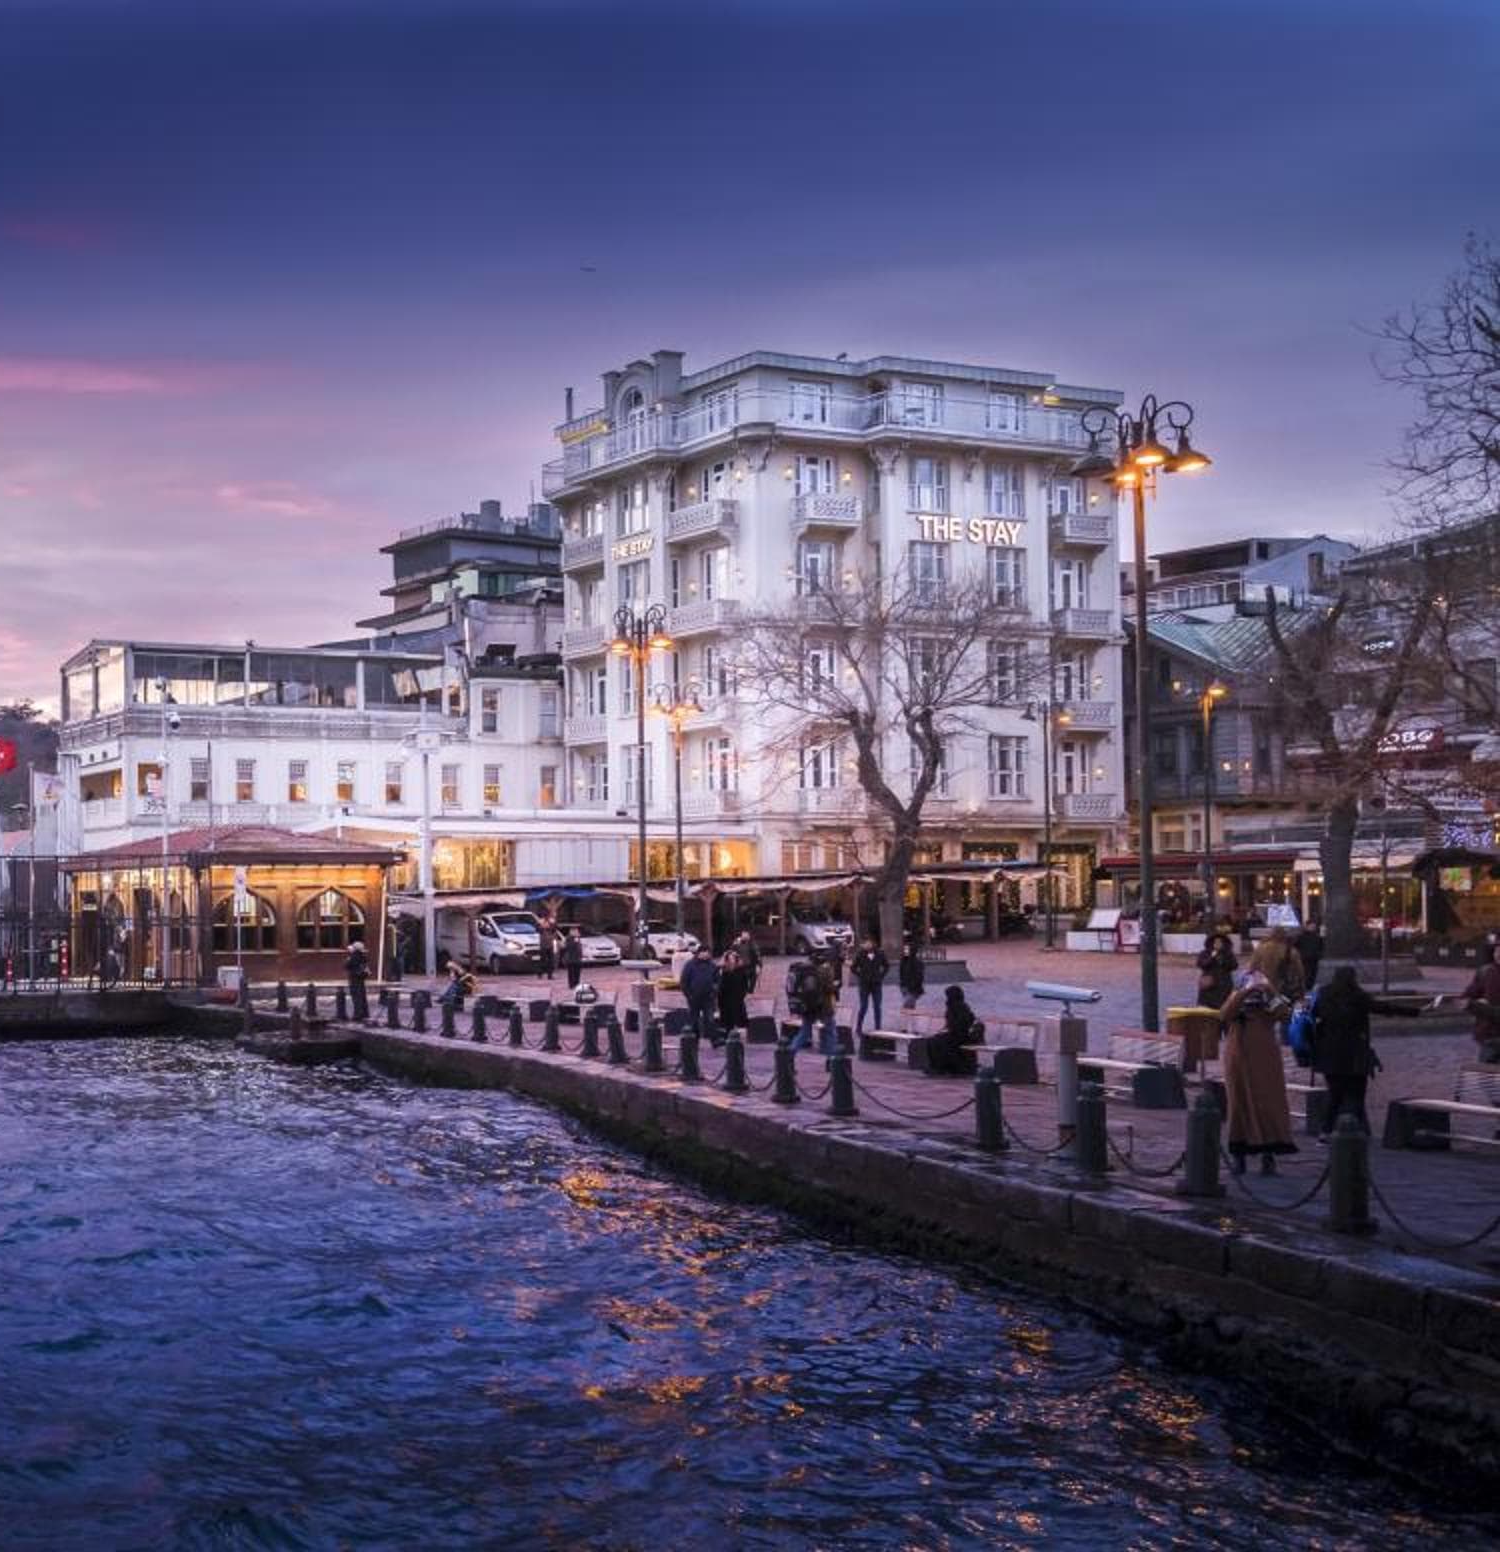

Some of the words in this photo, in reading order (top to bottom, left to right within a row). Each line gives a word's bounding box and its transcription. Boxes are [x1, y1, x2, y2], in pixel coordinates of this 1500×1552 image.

[916, 515, 963, 541] THE
[967, 518, 1021, 545] STAY
[611, 543, 629, 561] THE
